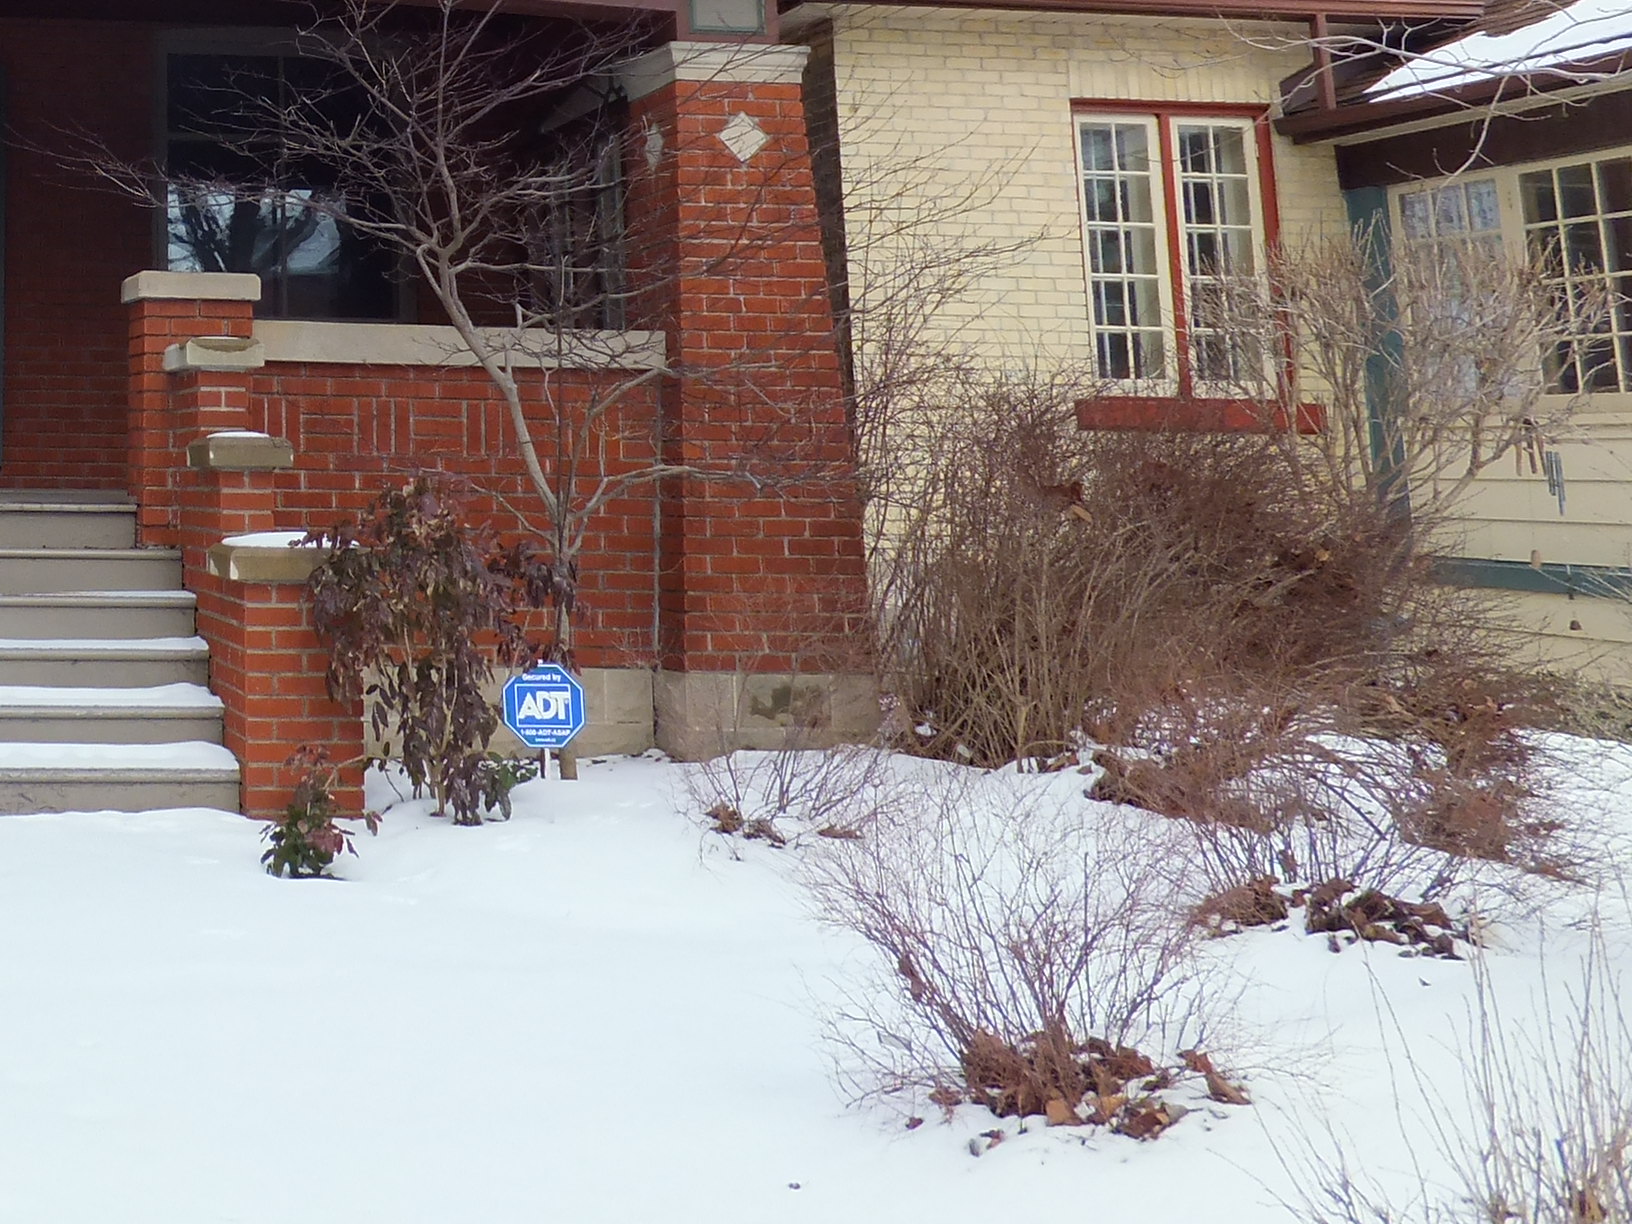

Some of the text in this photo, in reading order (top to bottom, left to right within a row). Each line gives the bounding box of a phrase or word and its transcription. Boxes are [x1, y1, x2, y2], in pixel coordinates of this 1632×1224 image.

[522, 673, 561, 682] Secured by
[518, 691, 570, 720] ADT
